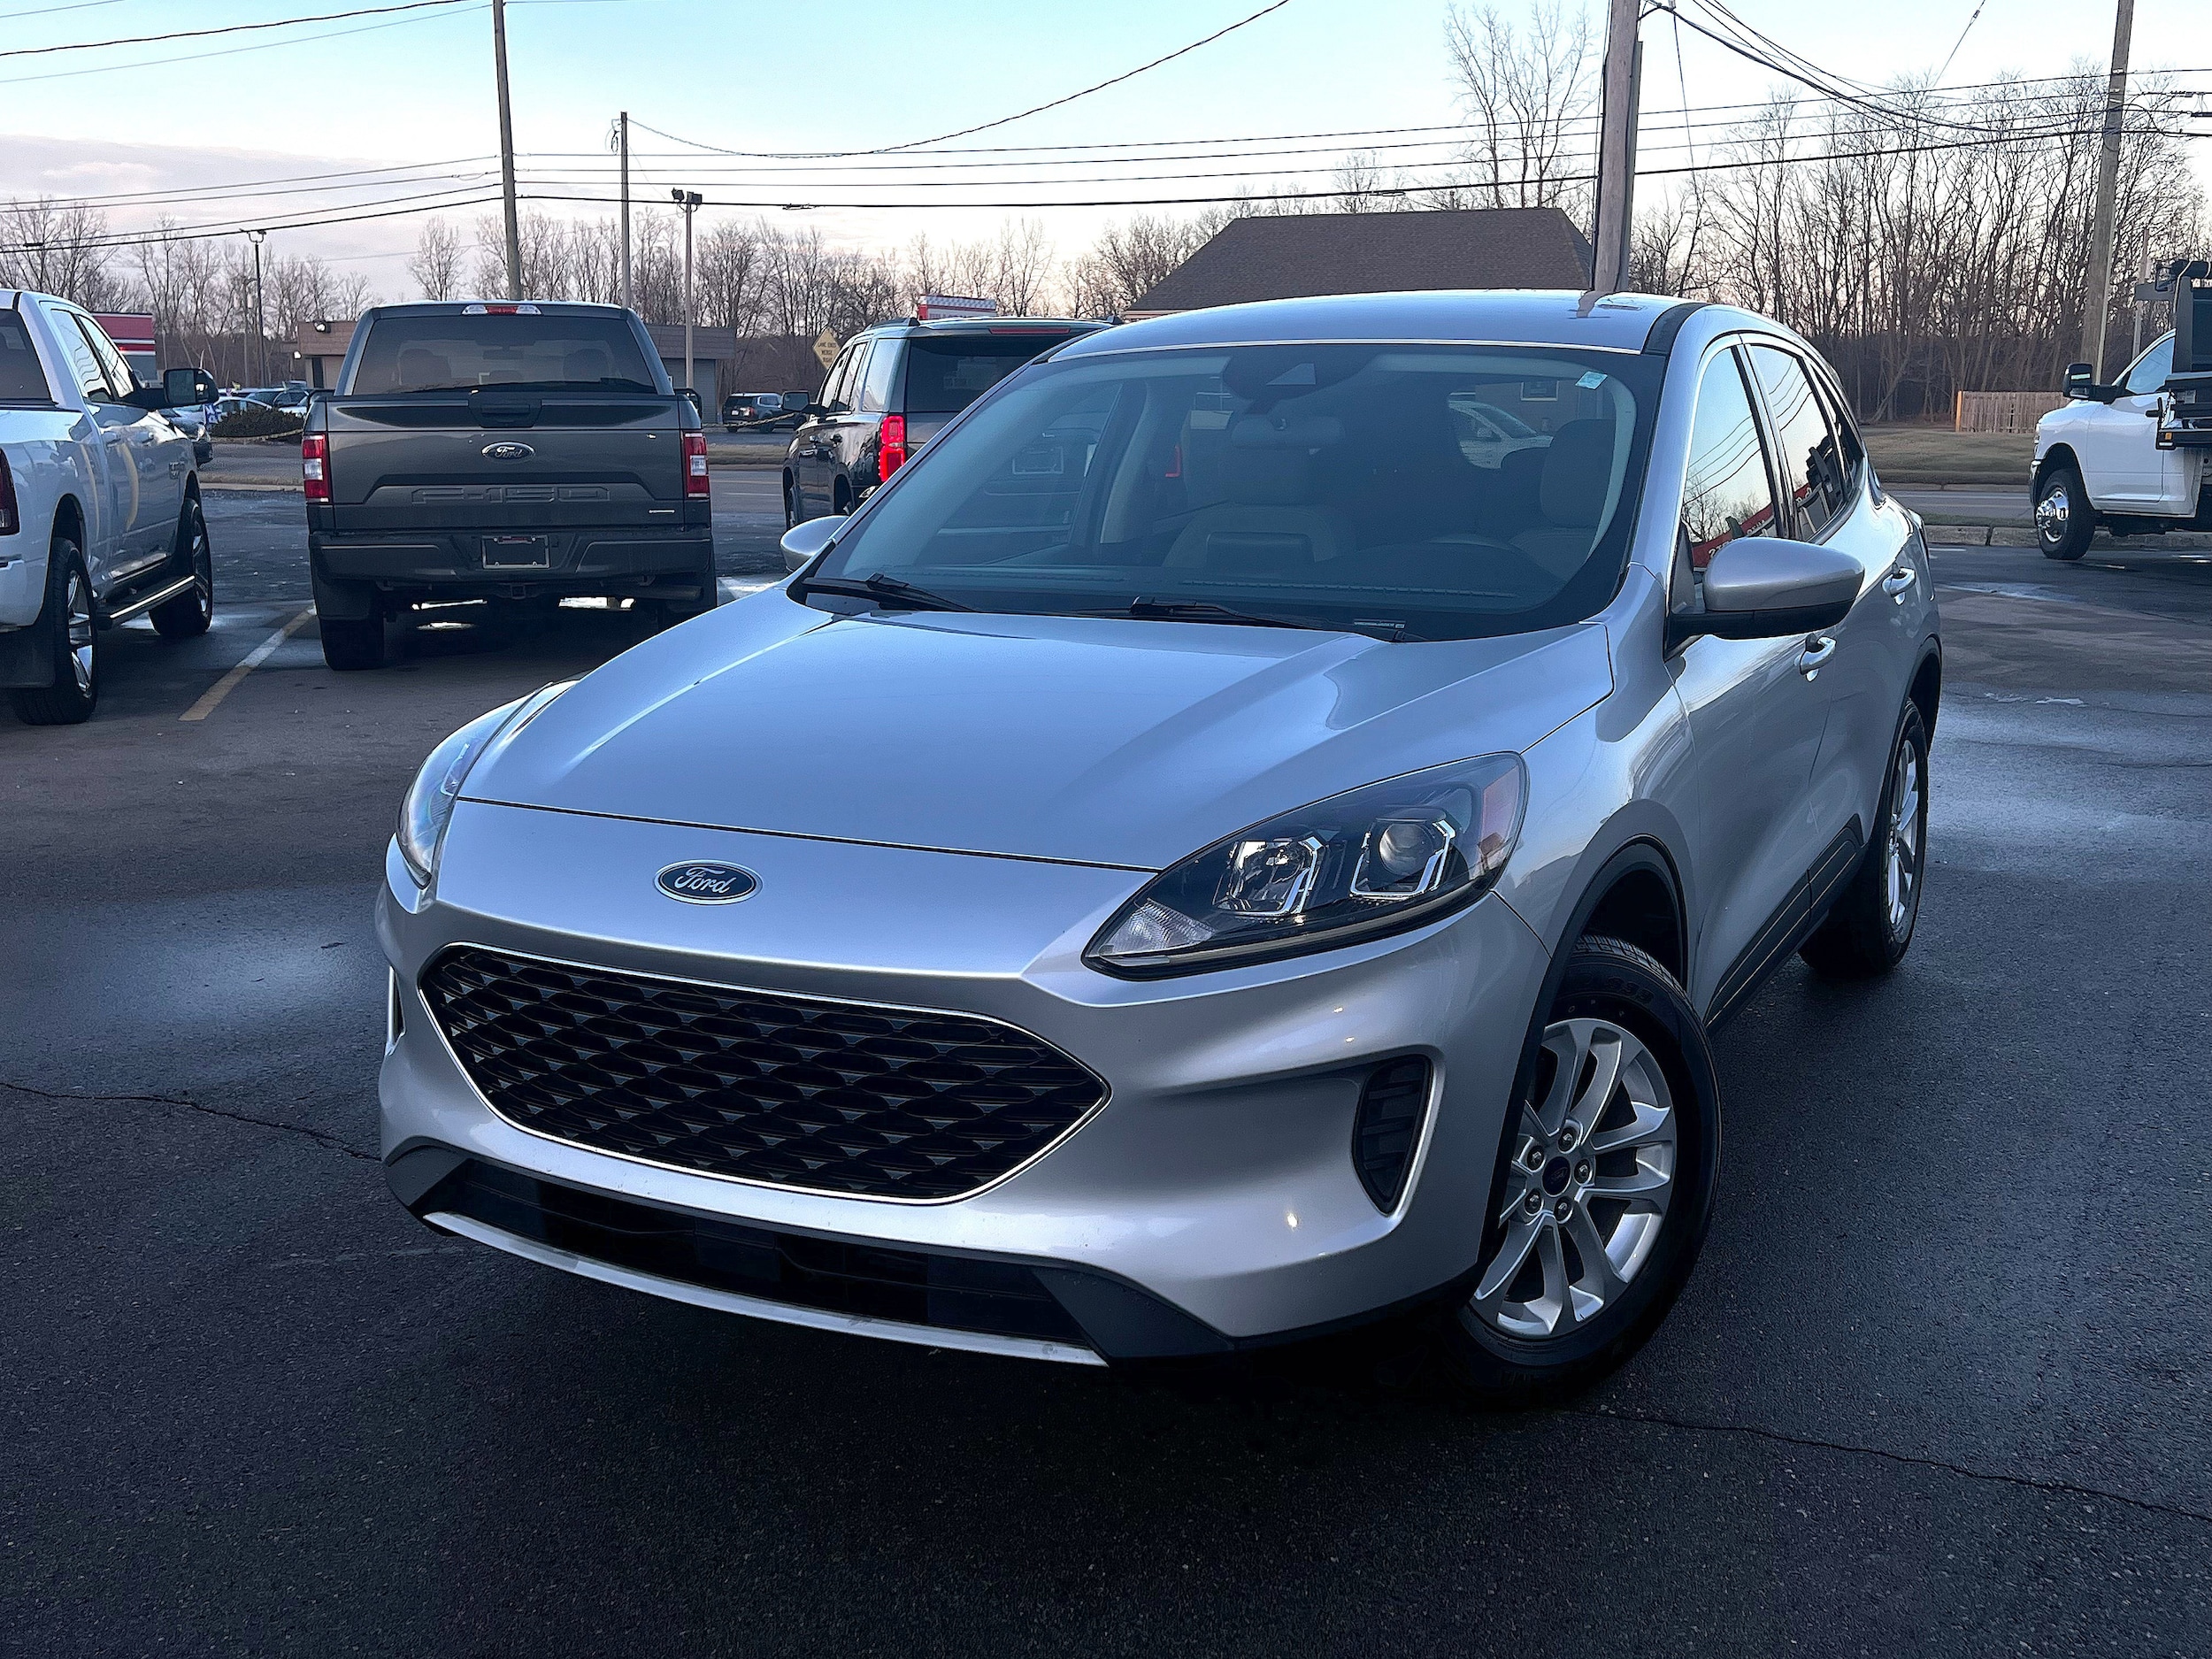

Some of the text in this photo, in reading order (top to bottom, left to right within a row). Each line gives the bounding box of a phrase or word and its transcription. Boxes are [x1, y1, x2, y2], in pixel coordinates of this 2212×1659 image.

[495, 446, 523, 457] Ford
[411, 488, 611, 503] F-150
[674, 867, 736, 893] Ford
